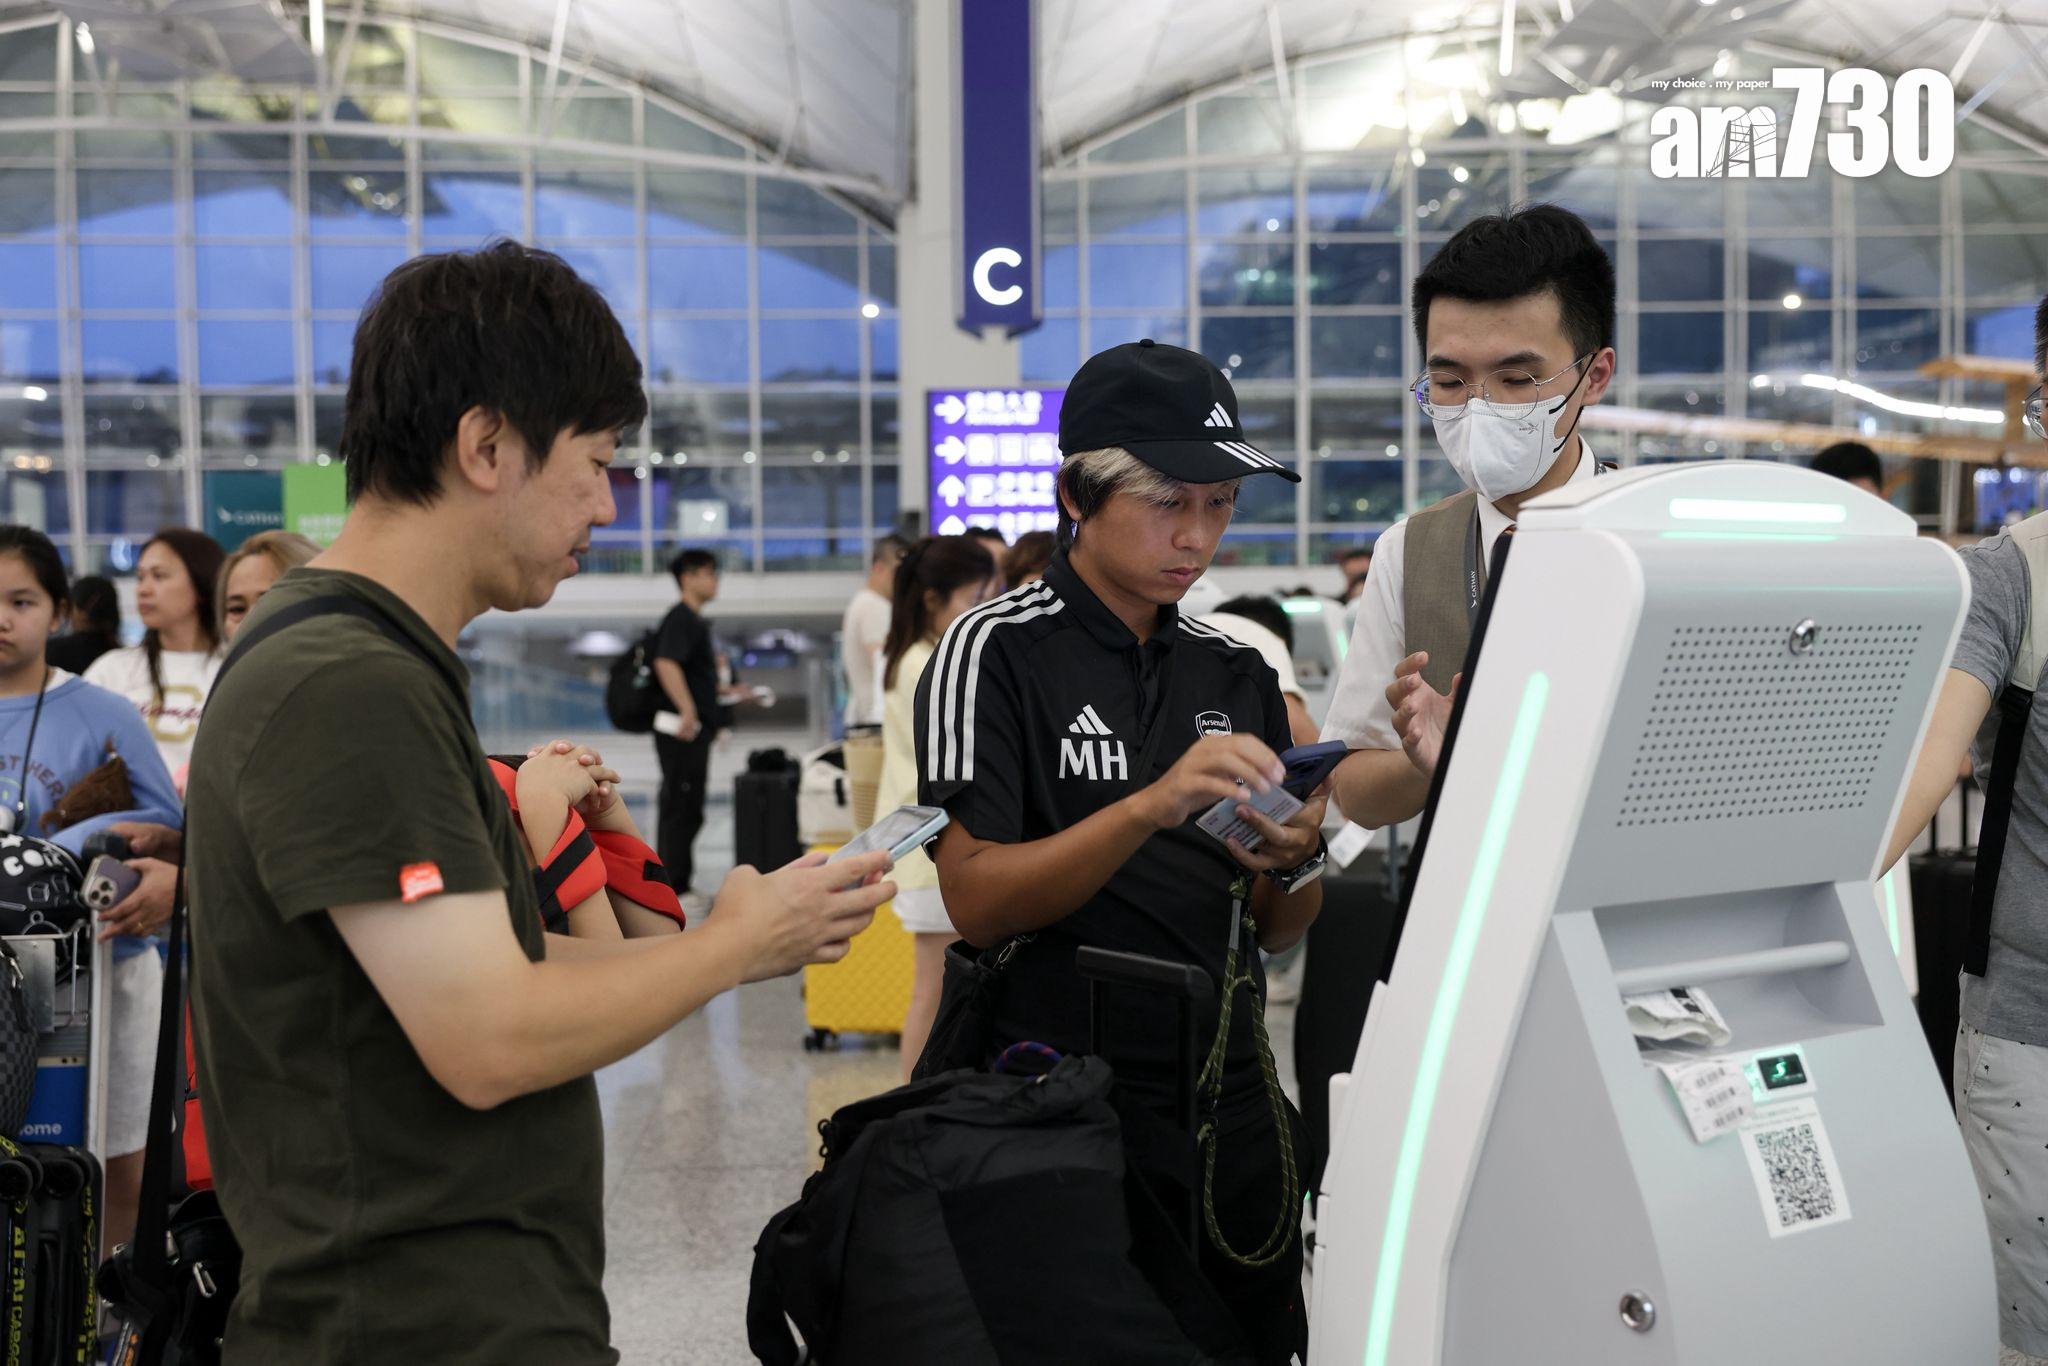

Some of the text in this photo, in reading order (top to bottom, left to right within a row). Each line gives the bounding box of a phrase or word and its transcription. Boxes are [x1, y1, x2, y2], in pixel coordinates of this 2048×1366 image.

[973, 247, 1024, 306] C
[1201, 719, 1227, 728] Arsenal
[1058, 738, 1128, 781] MH
[20, 1122, 62, 1137] ome
